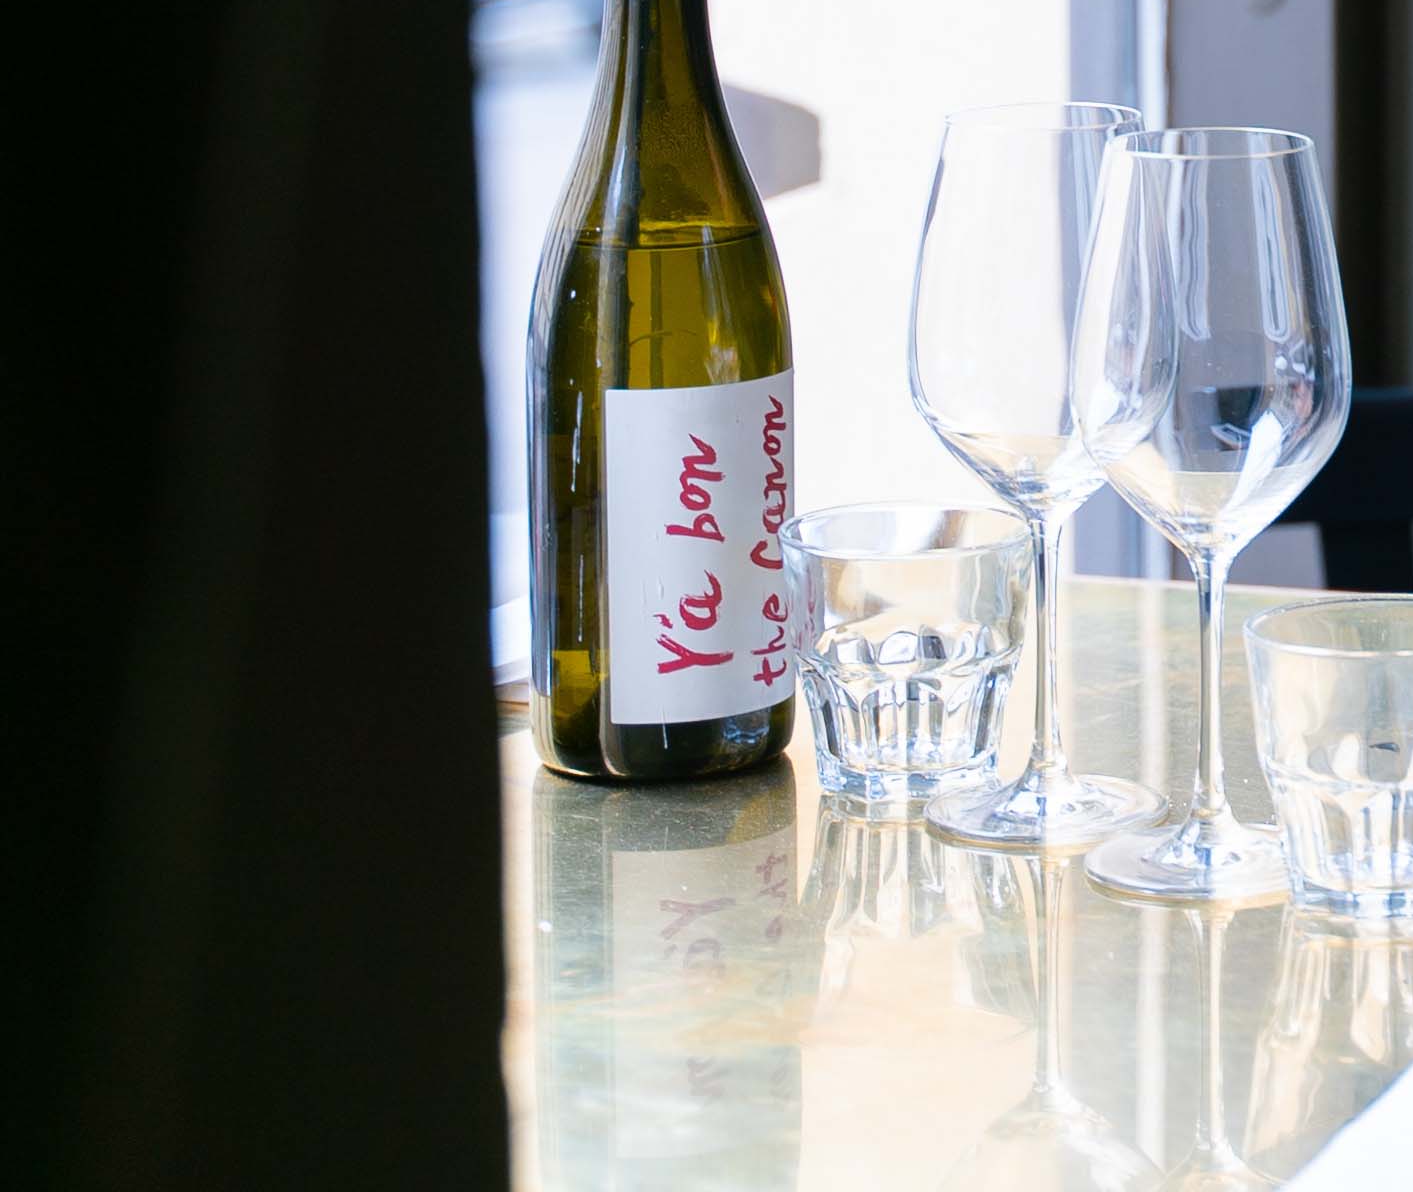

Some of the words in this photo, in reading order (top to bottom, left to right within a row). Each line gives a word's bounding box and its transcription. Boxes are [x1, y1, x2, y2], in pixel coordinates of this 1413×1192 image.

[665, 433, 727, 543] bon
[656, 570, 734, 674] Y'a
[750, 592, 788, 687] the
